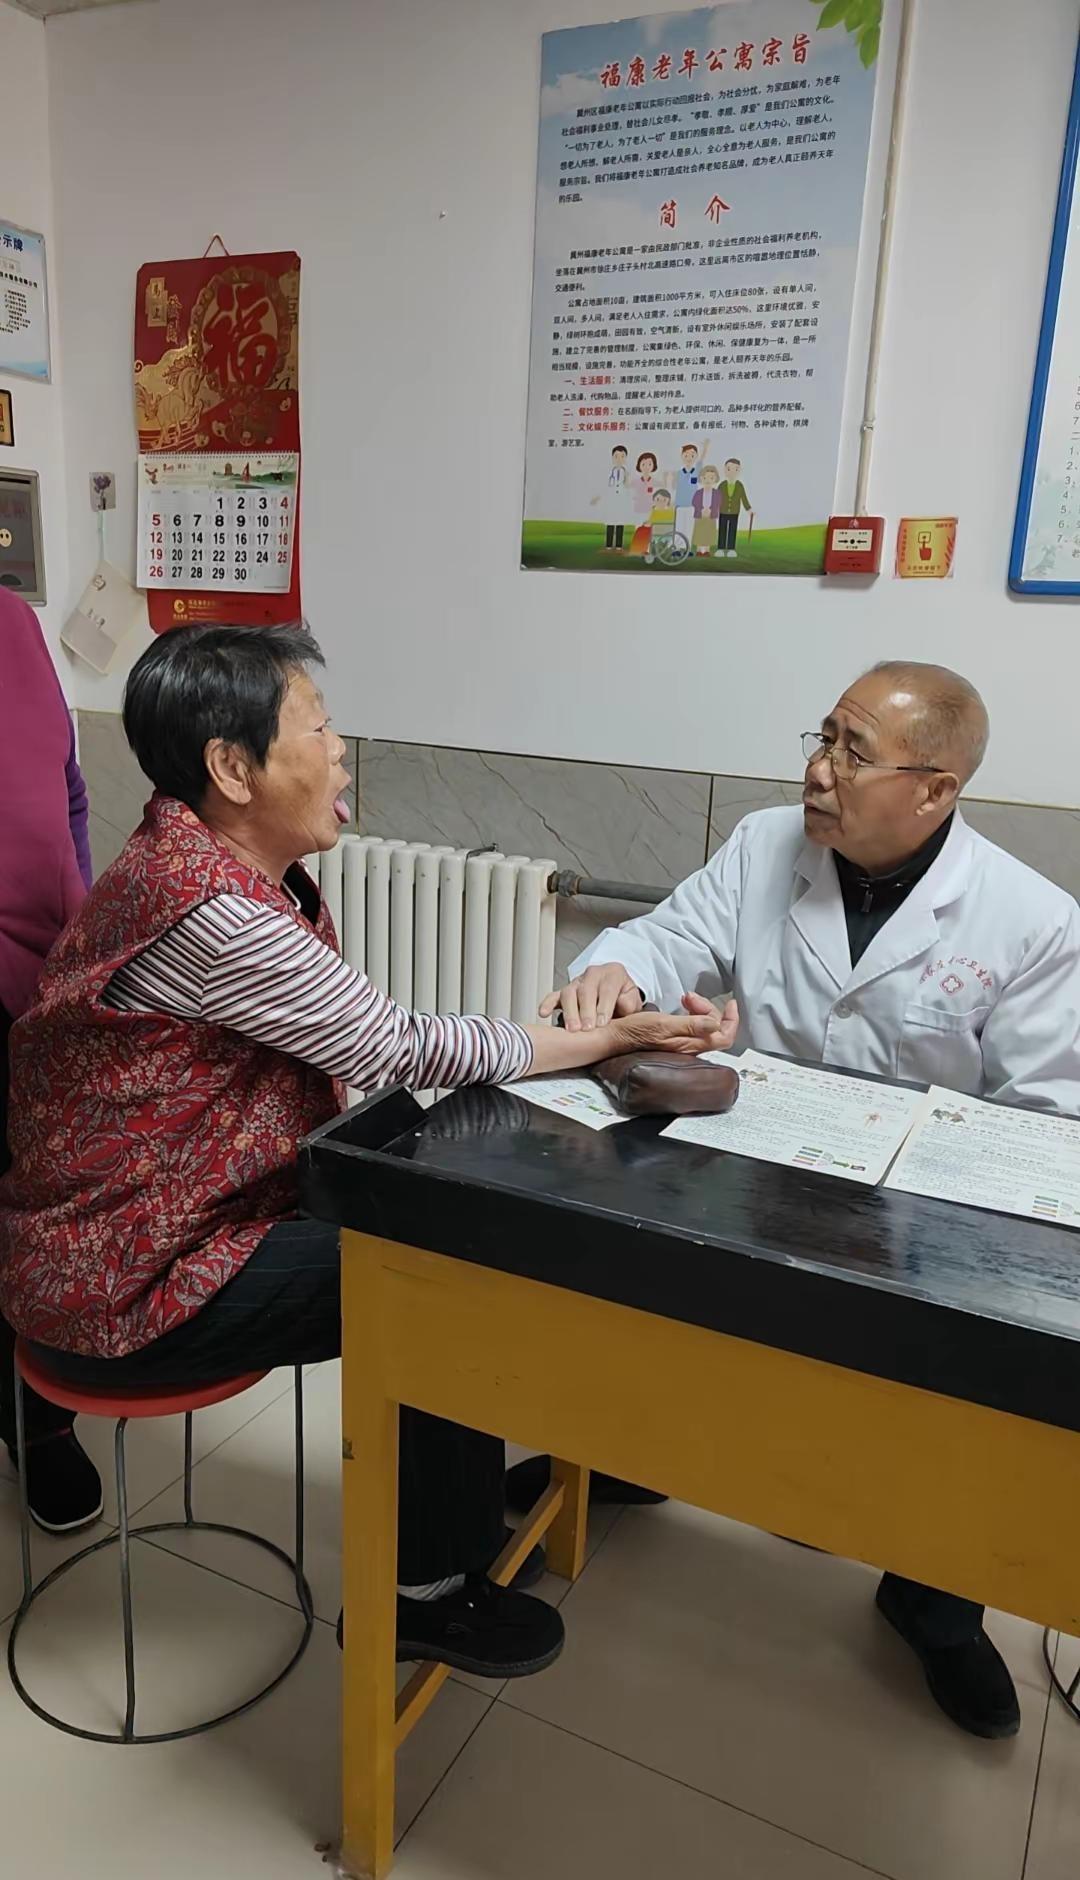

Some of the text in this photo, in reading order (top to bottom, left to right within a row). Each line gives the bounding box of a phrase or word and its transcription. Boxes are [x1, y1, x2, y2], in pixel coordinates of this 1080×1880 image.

[600, 34, 812, 89] 福康老年公寓宗旨
[0, 234, 23, 252] 示牌
[217, 497, 288, 510] 1 2 3 4
[152, 514, 289, 527] 5 6 7 8 9 10 11
[150, 532, 288, 546] 12 13 14 15 16 17 18
[150, 549, 288, 564] 19 20 21 22 23 24 25
[149, 565, 247, 580] 26 27 28 29 30
